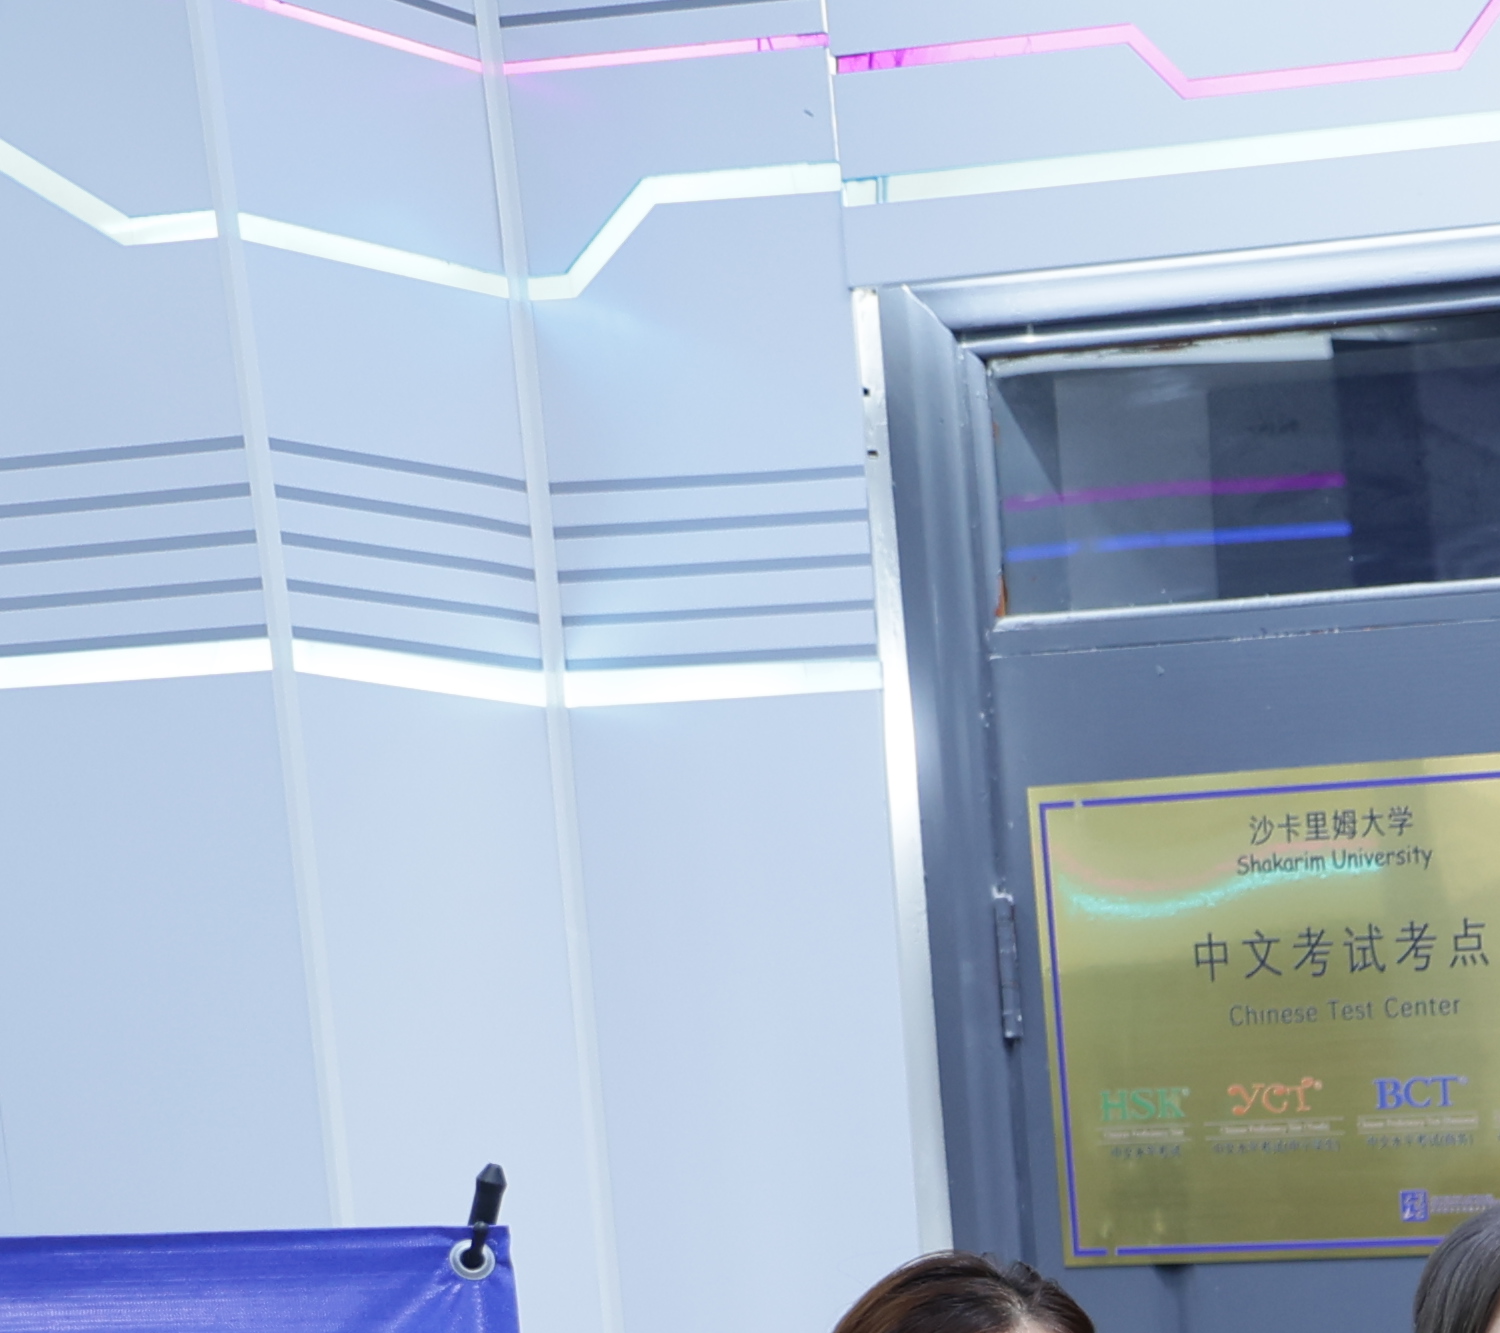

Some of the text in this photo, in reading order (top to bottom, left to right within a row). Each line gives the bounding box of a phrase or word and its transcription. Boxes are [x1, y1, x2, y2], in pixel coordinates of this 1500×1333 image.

[1249, 805, 1413, 846] 沙卡里姆大学
[1236, 845, 1434, 876] Shakarim University
[1193, 917, 1490, 983] 中文考试考点
[1229, 994, 1462, 1029] Chinese Test Center
